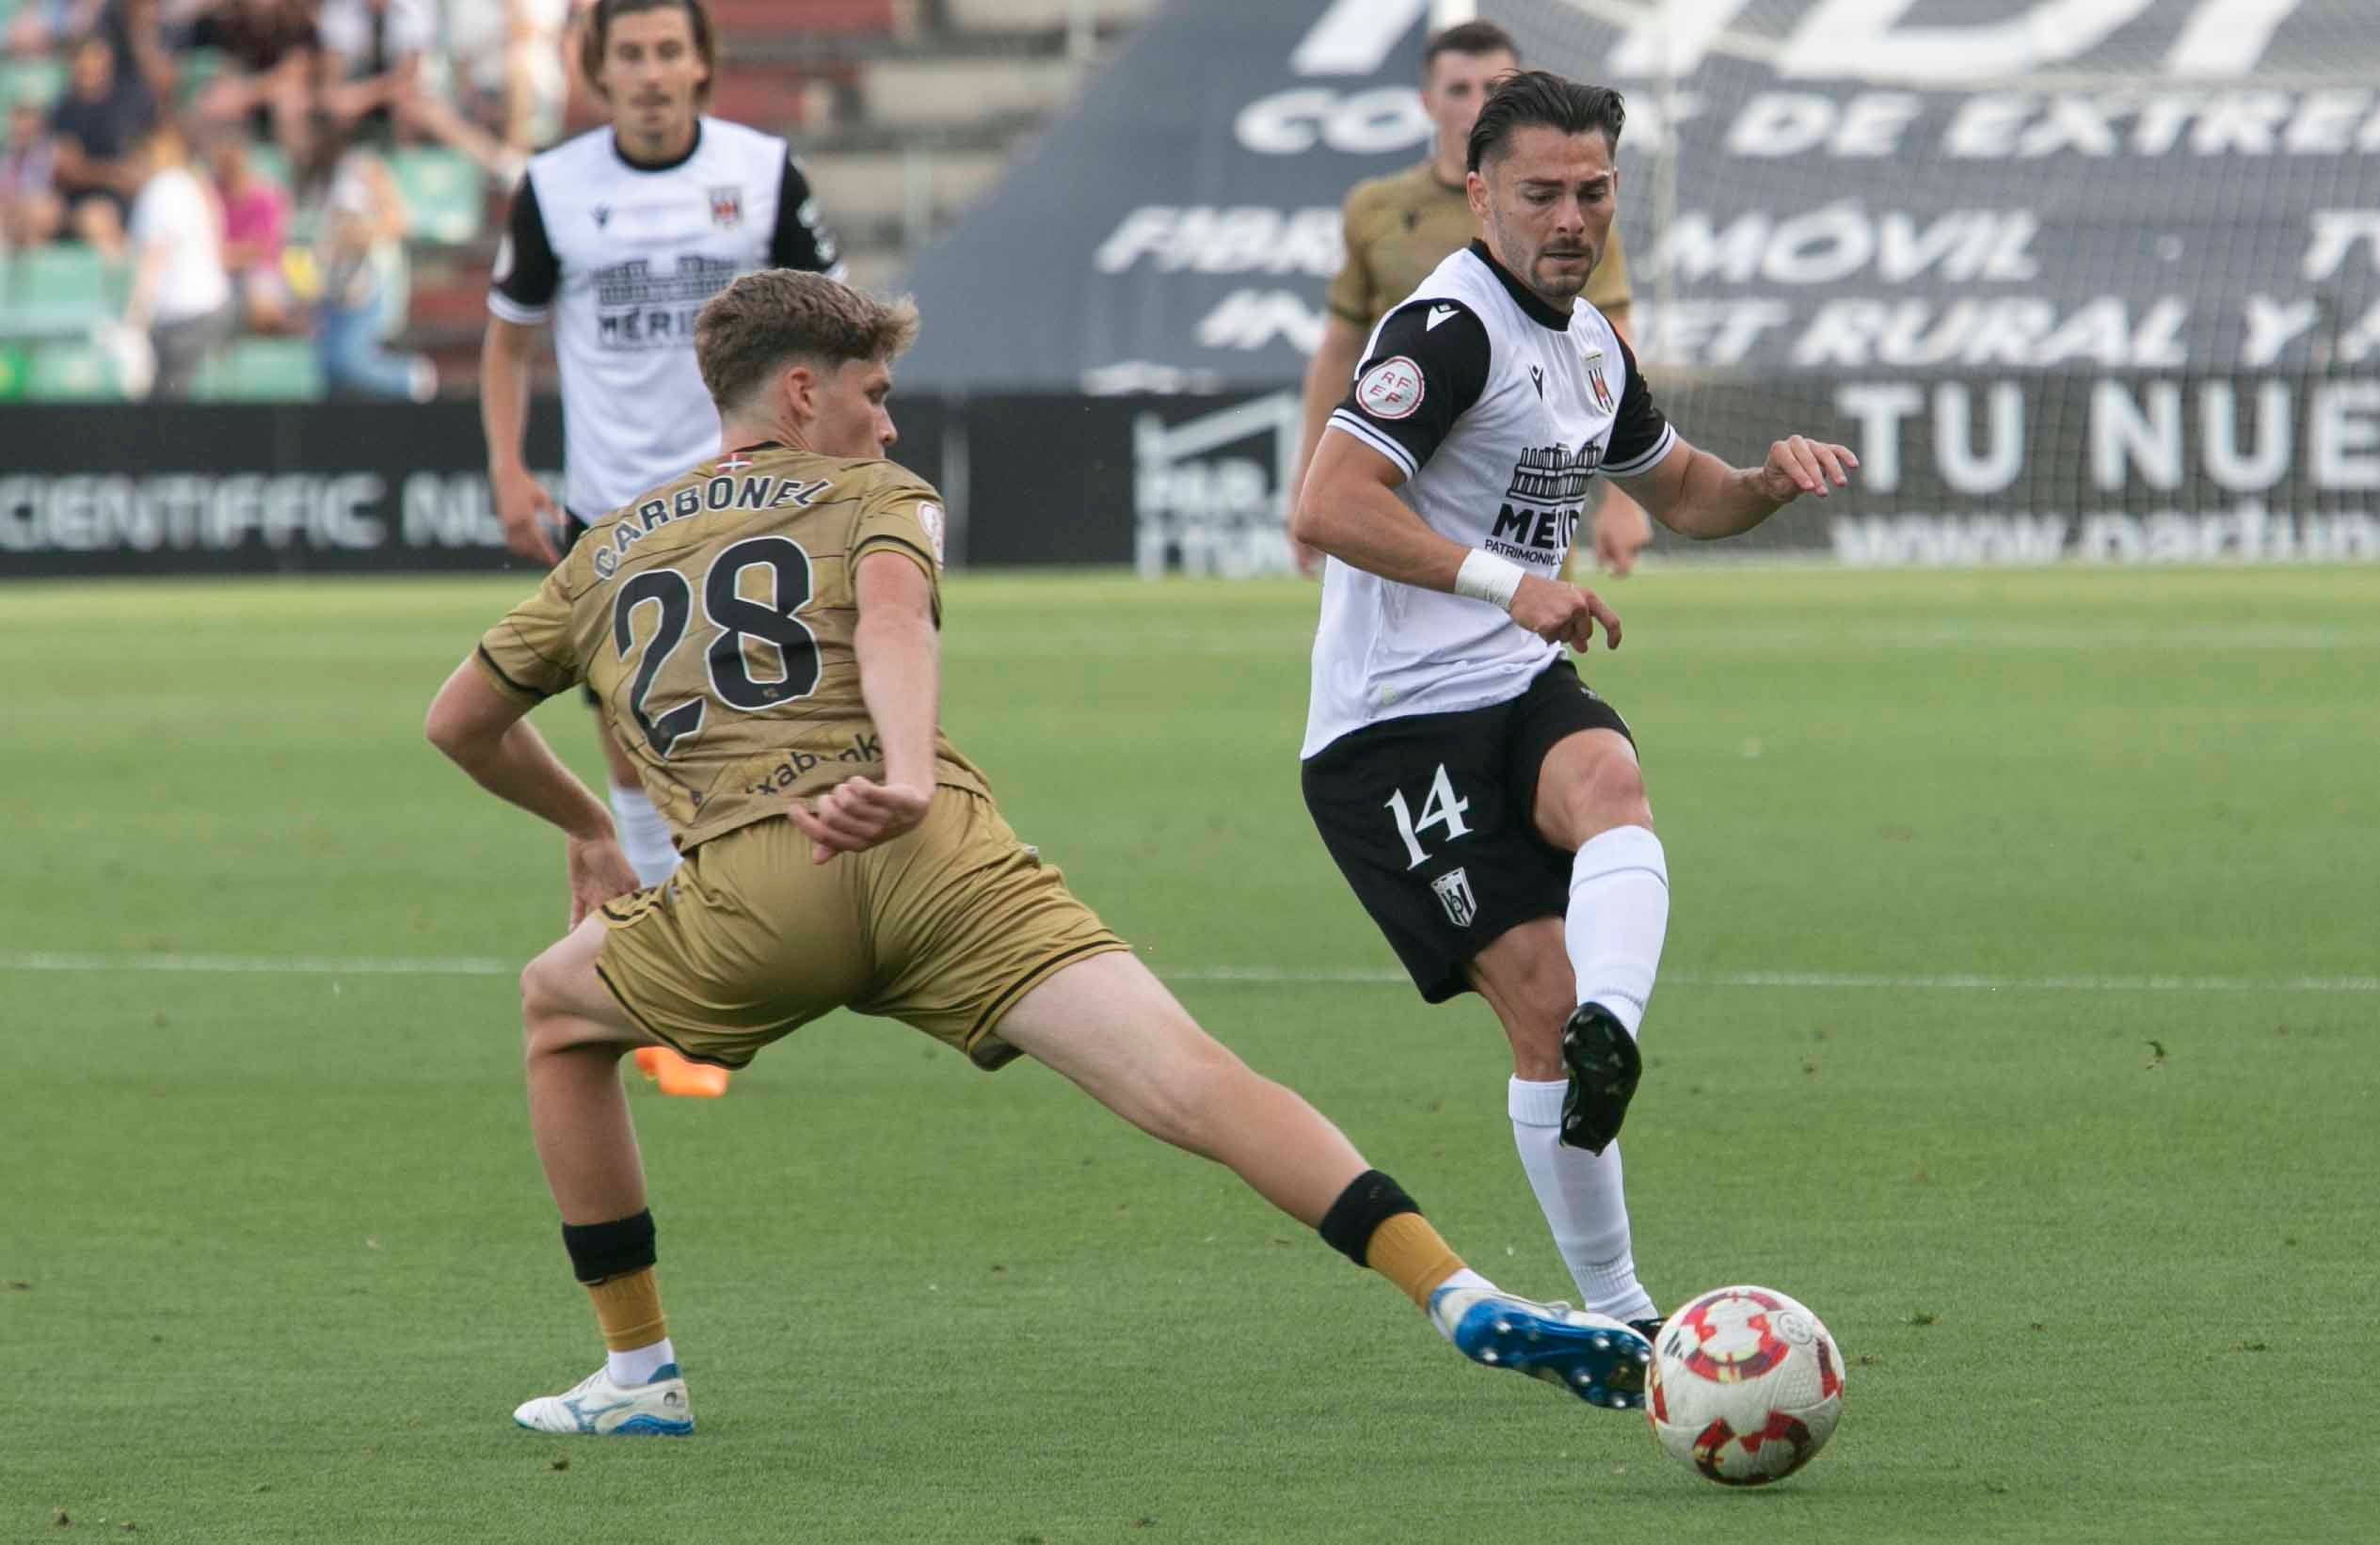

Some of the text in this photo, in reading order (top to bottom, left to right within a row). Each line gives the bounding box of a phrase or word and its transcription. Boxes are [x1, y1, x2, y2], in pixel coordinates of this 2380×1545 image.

[1730, 91, 1922, 158] DE
[1094, 205, 1346, 276] FIBR
[1642, 199, 2040, 284] MÓVIL
[597, 306, 698, 341] MÉRI
[1790, 294, 2189, 368] RURAL
[2243, 294, 2321, 368] Y
[1833, 378, 2380, 495] TU NUE
[614, 534, 823, 760] 28
[1383, 762, 1475, 871] 14
